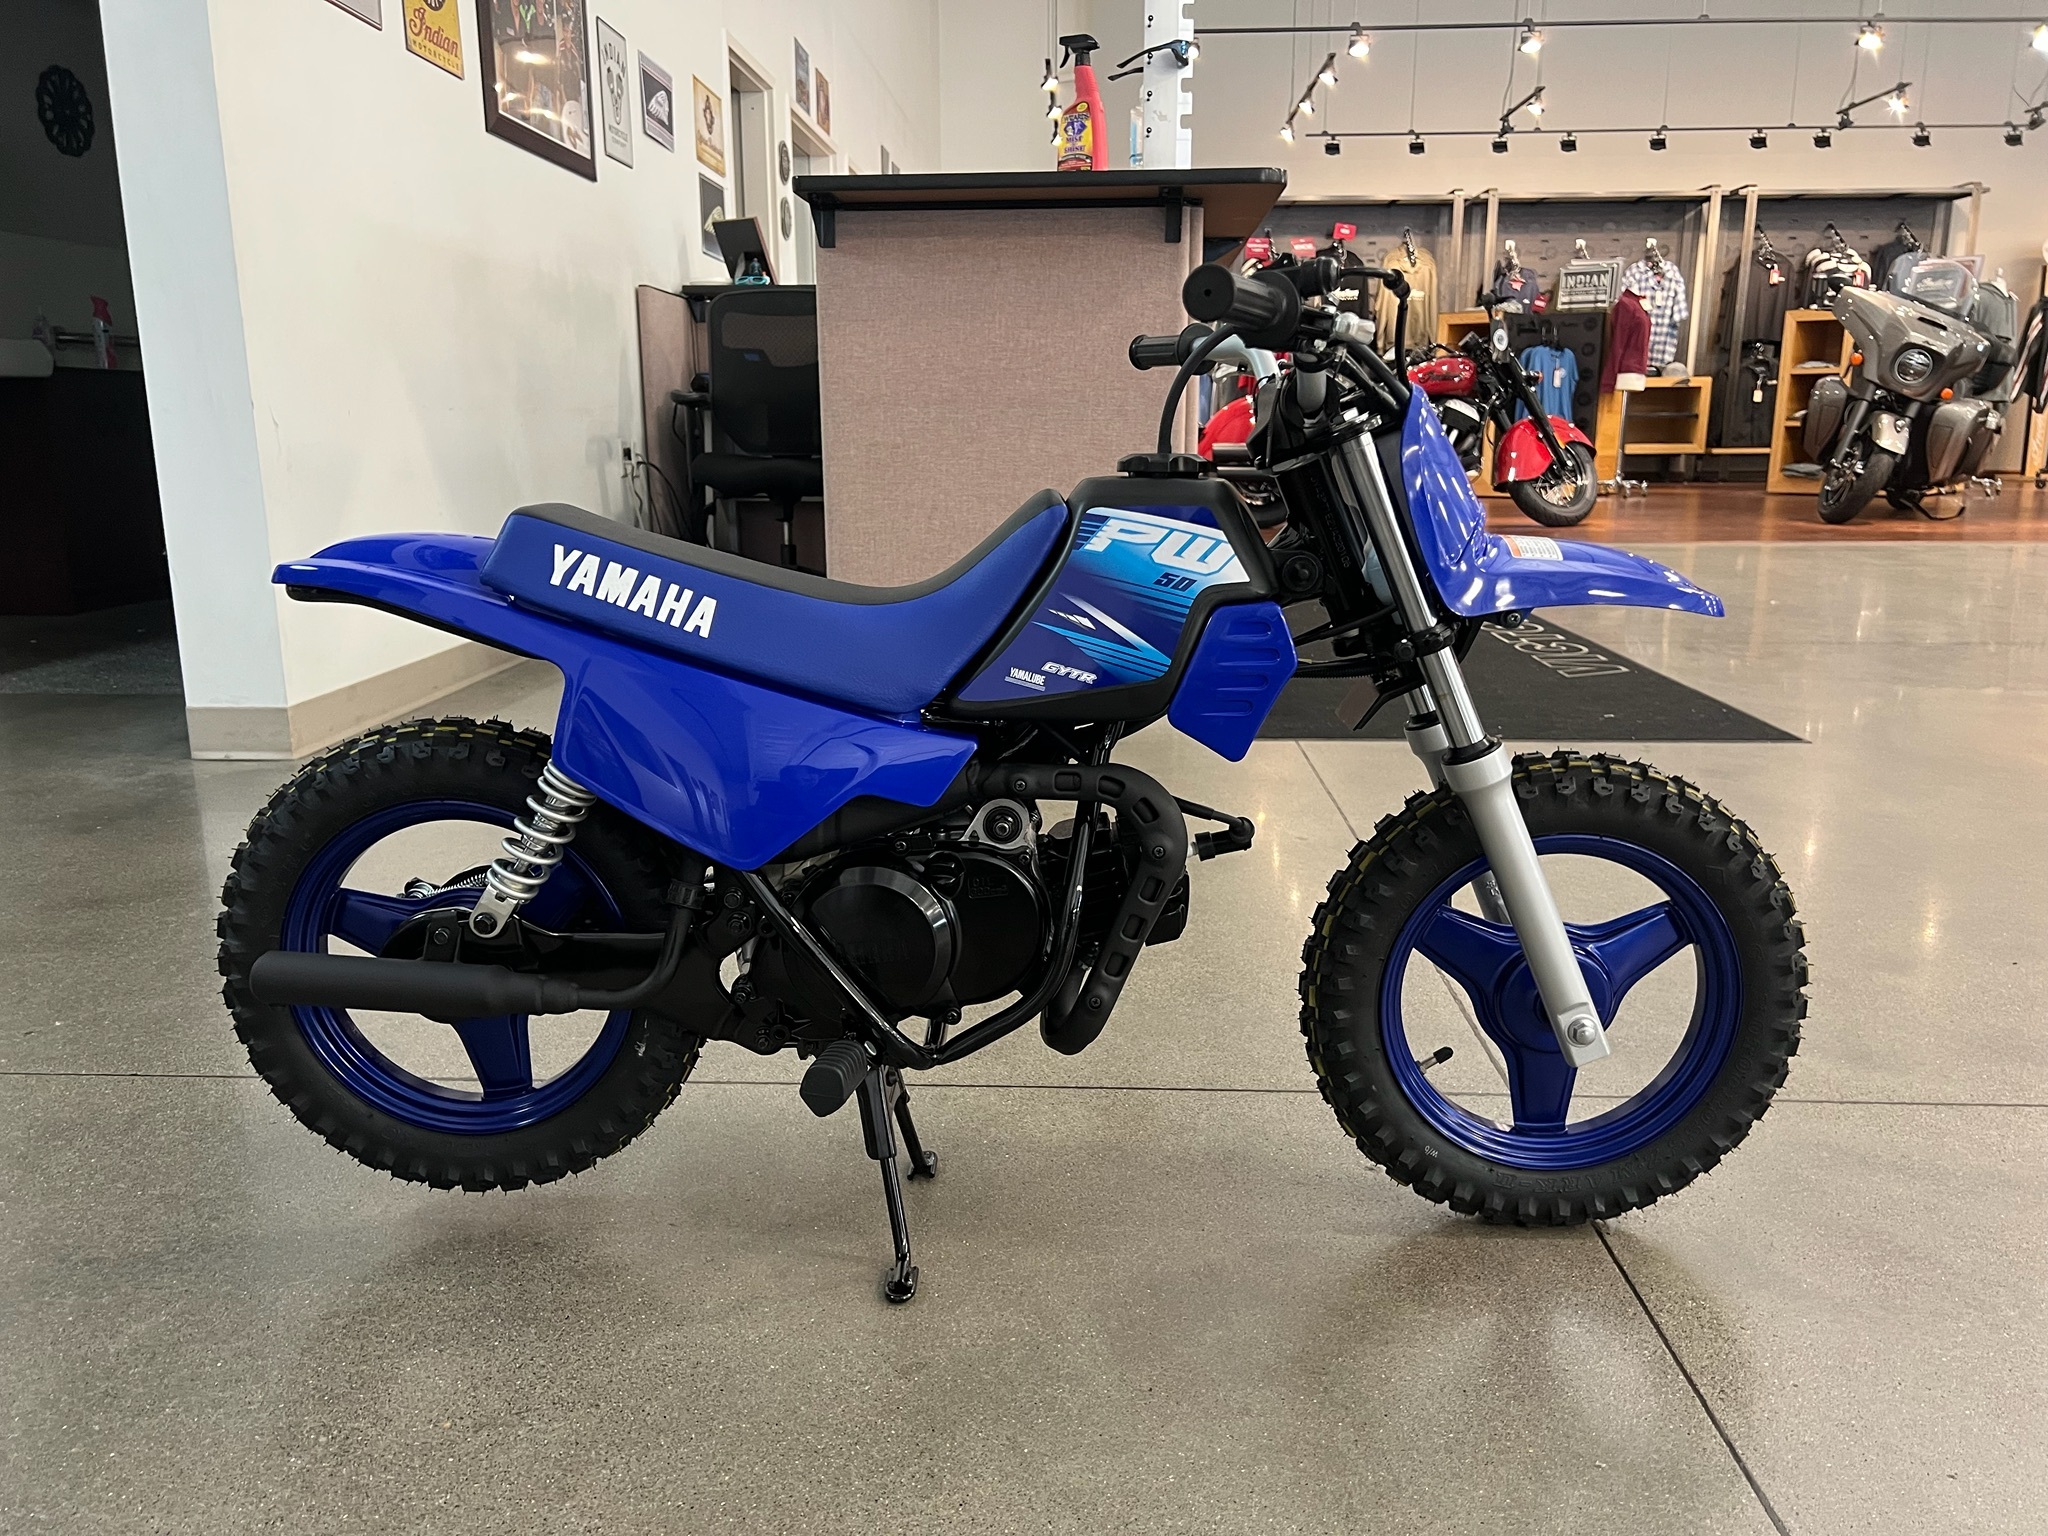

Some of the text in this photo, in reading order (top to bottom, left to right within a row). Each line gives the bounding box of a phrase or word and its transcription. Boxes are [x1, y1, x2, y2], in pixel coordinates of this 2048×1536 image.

[409, 7, 461, 60] Indian
[601, 42, 626, 78] INDIAN
[1561, 272, 1609, 288] INDIAN
[1083, 516, 1238, 576] PW
[549, 543, 718, 639] YAMAHA
[1153, 571, 1197, 592] 50
[1009, 666, 1046, 686] YAMALUBE
[1041, 661, 1098, 685] GYTR
